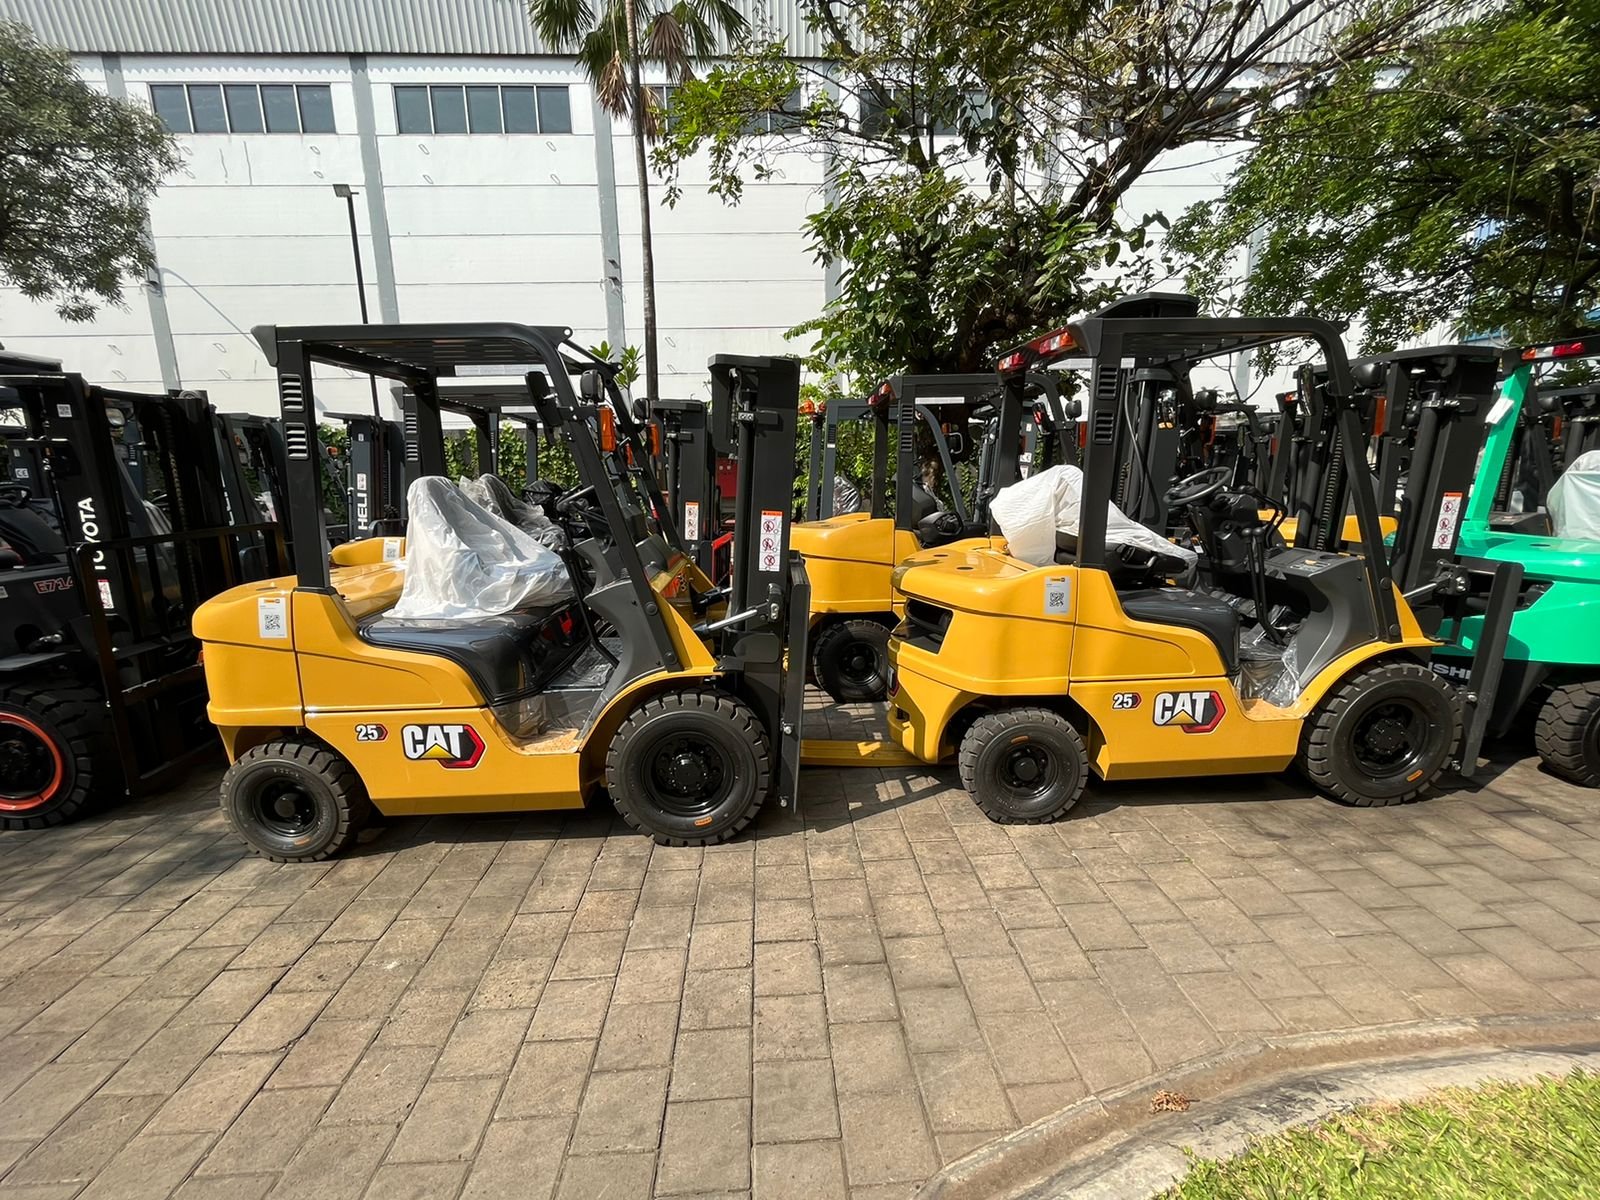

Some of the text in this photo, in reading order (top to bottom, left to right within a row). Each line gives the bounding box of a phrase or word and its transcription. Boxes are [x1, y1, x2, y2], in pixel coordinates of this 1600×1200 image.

[356, 493, 368, 531] HELI
[1112, 693, 1133, 709] 25
[1154, 691, 1211, 726] CAT
[355, 724, 378, 741] 25
[402, 724, 464, 760] CAT
